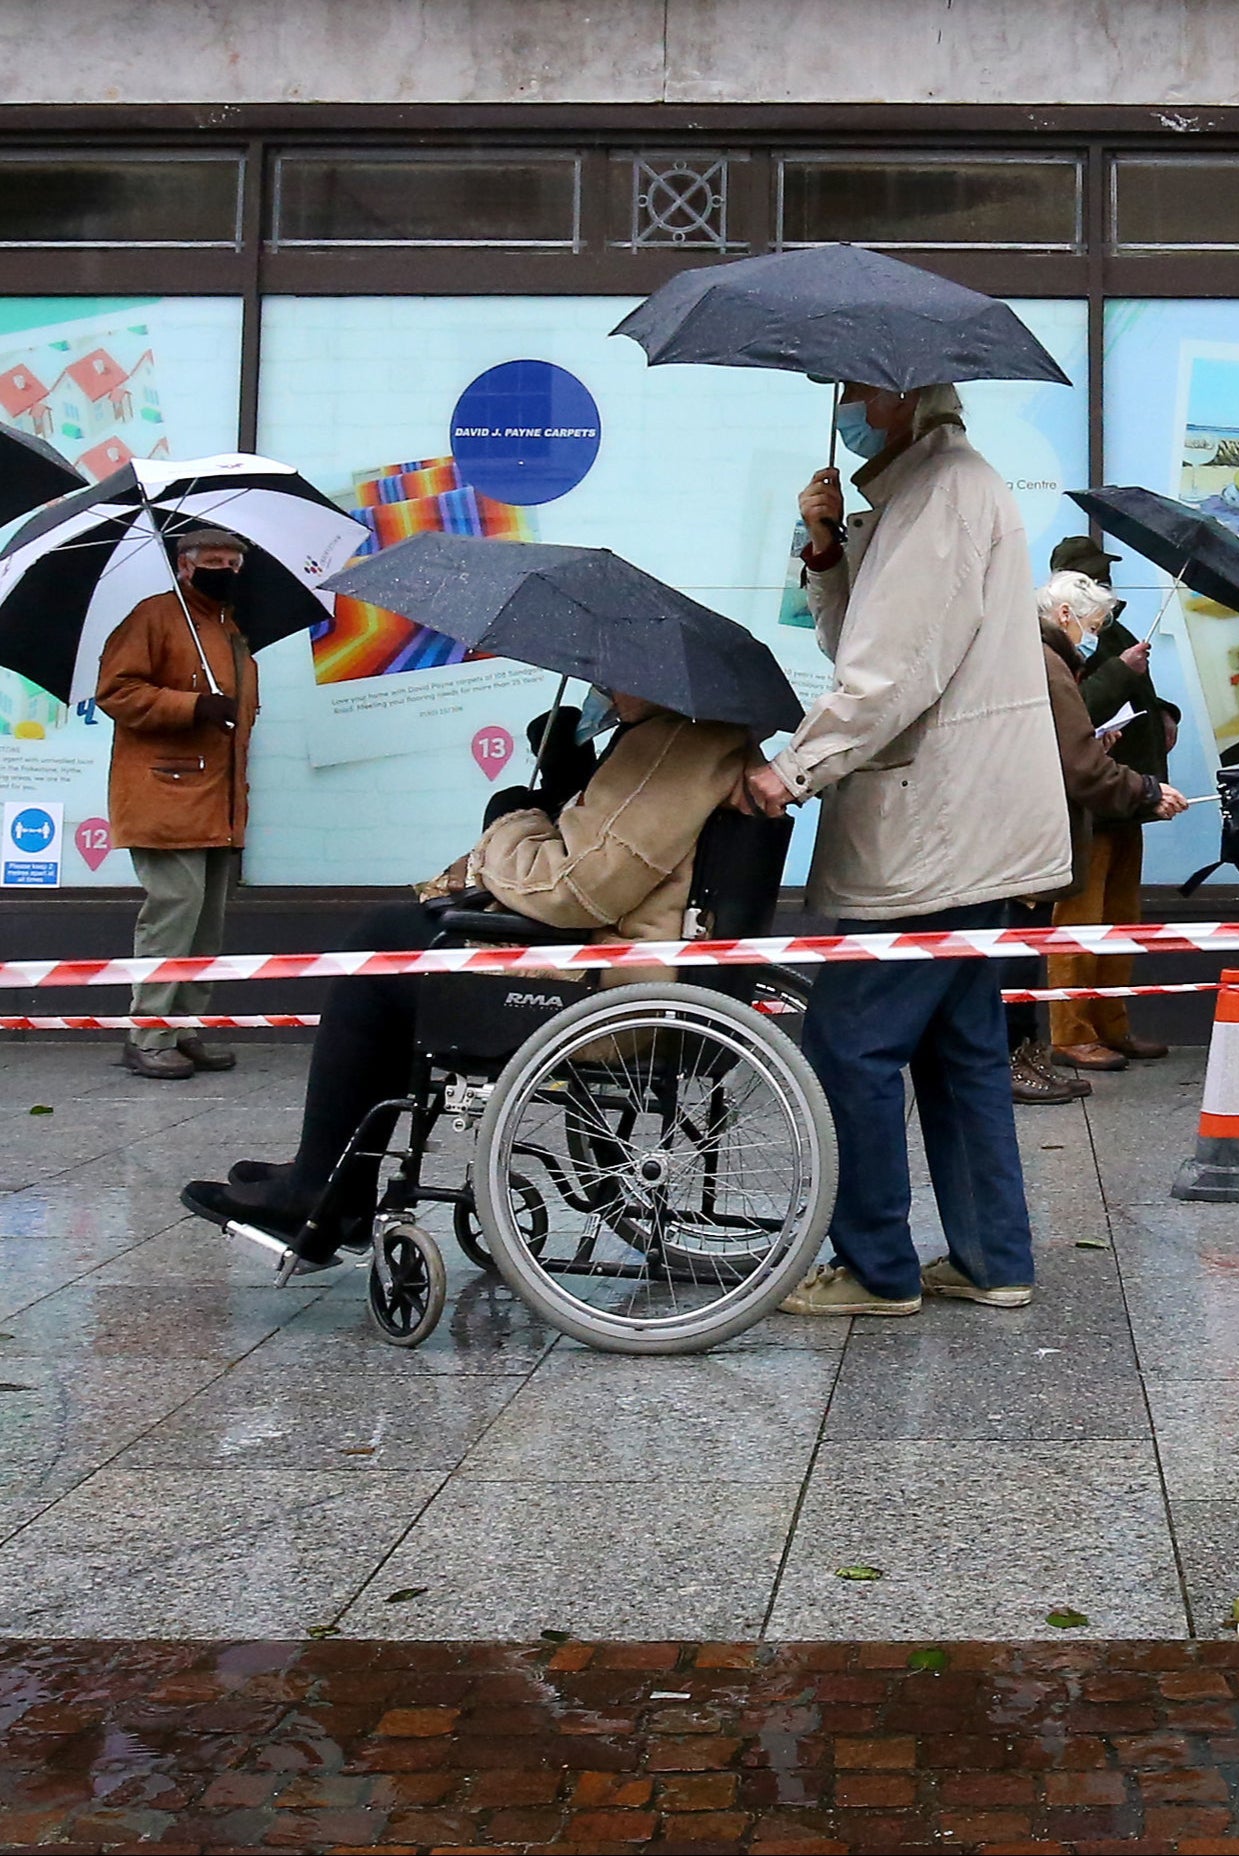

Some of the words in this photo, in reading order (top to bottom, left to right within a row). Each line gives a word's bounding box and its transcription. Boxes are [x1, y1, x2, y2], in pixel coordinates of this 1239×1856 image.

[455, 428, 489, 437] DAVID
[491, 428, 502, 437] J.
[504, 428, 541, 437] PAYNE
[544, 428, 596, 438] CARPETS
[1017, 480, 1057, 490] Centre
[479, 737, 506, 758] 13
[81, 829, 108, 849] 12
[505, 992, 564, 1007] RMA
